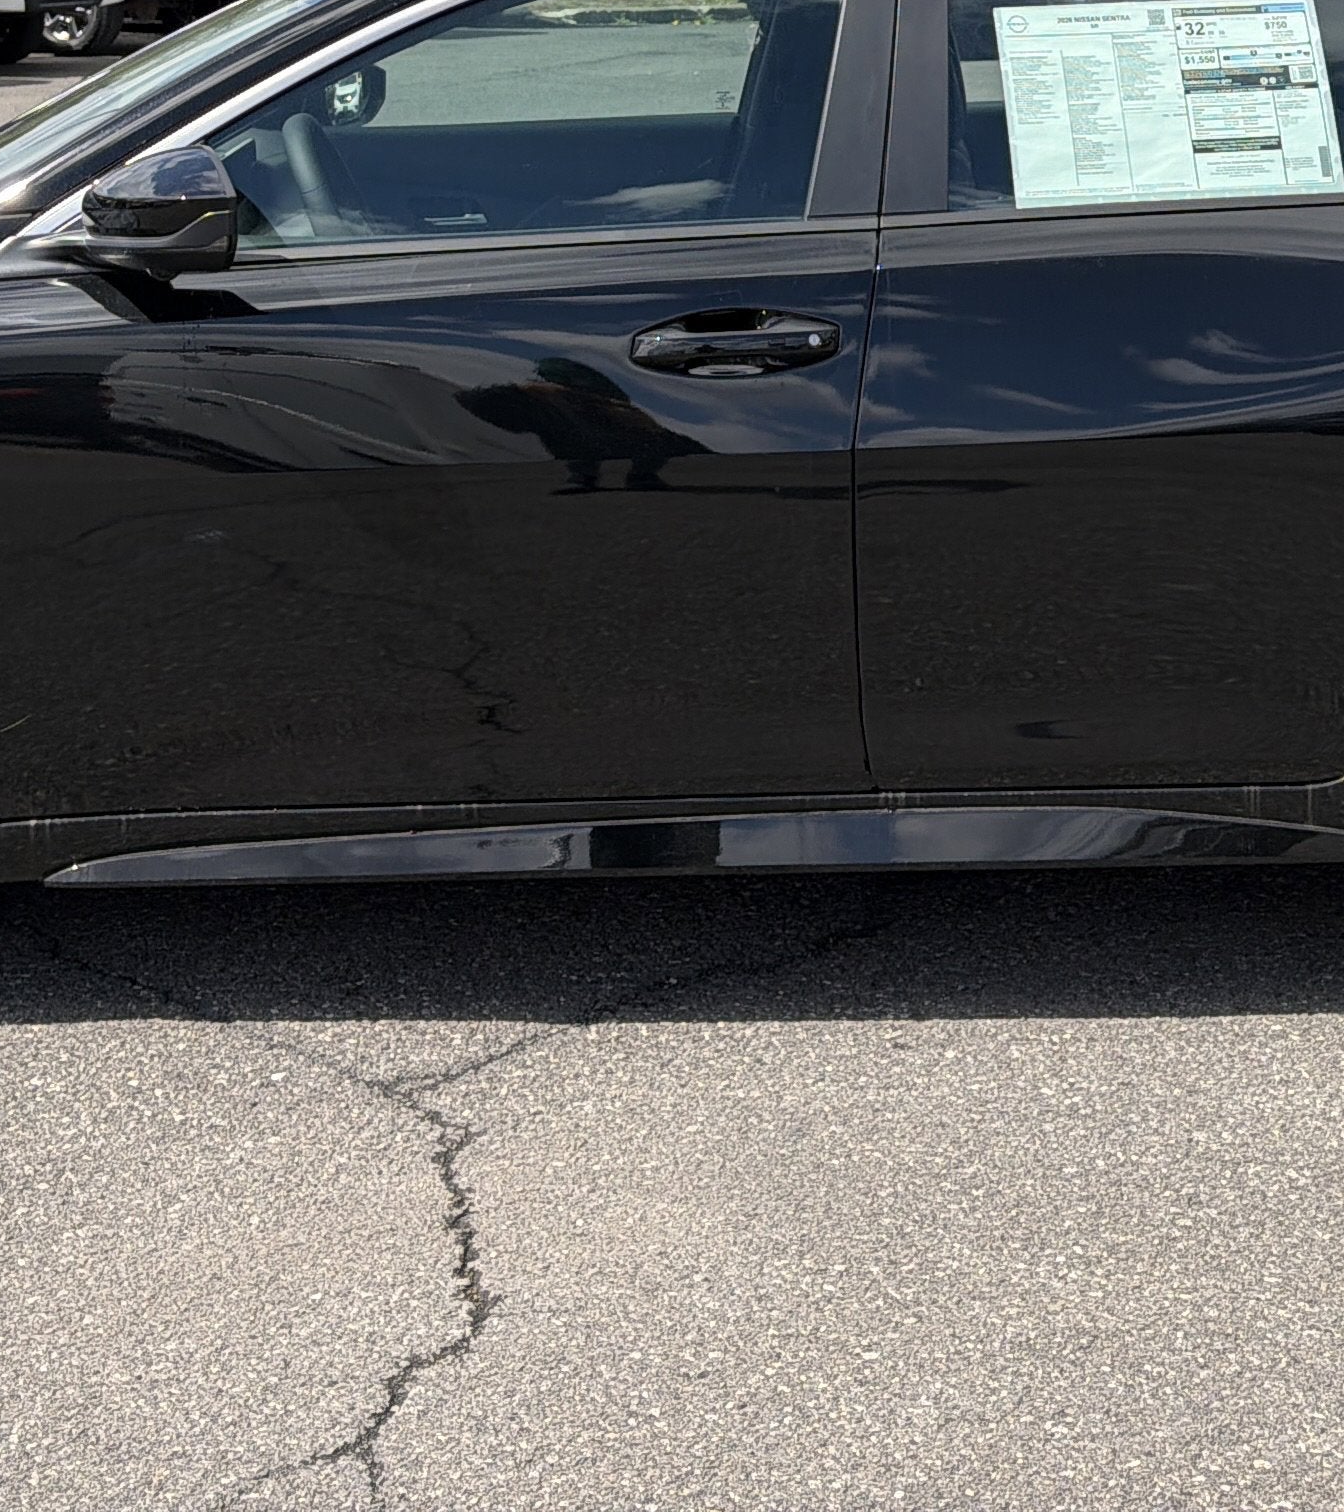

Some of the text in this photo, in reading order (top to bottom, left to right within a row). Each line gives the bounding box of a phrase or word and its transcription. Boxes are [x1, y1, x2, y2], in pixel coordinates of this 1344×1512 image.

[1074, 15, 1100, 23] NISSAN
[1184, 21, 1206, 36] 32
[1264, 20, 1288, 30] $750
[1184, 55, 1216, 65] $1,550
